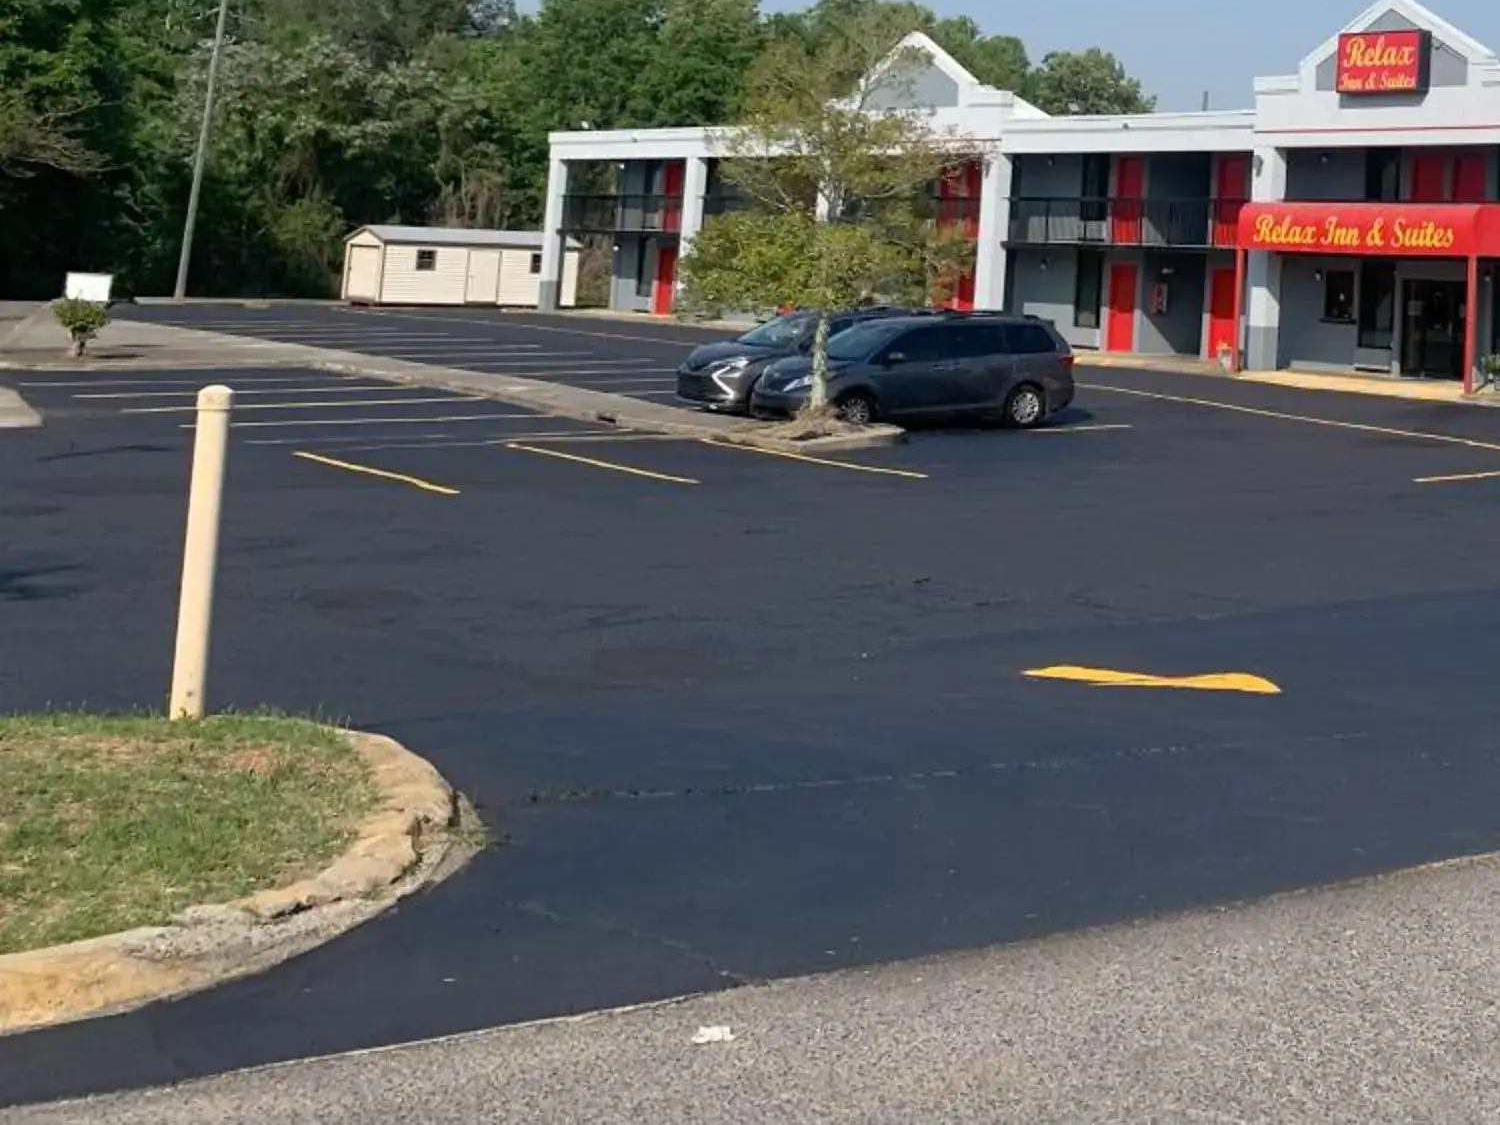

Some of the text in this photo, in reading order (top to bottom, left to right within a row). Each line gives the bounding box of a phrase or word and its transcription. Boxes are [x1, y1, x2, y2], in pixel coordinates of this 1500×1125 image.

[1343, 35, 1416, 69] Relax
[1340, 70, 1416, 90] Inn & Suites
[1253, 213, 1455, 248] Relax Inn & Suites
